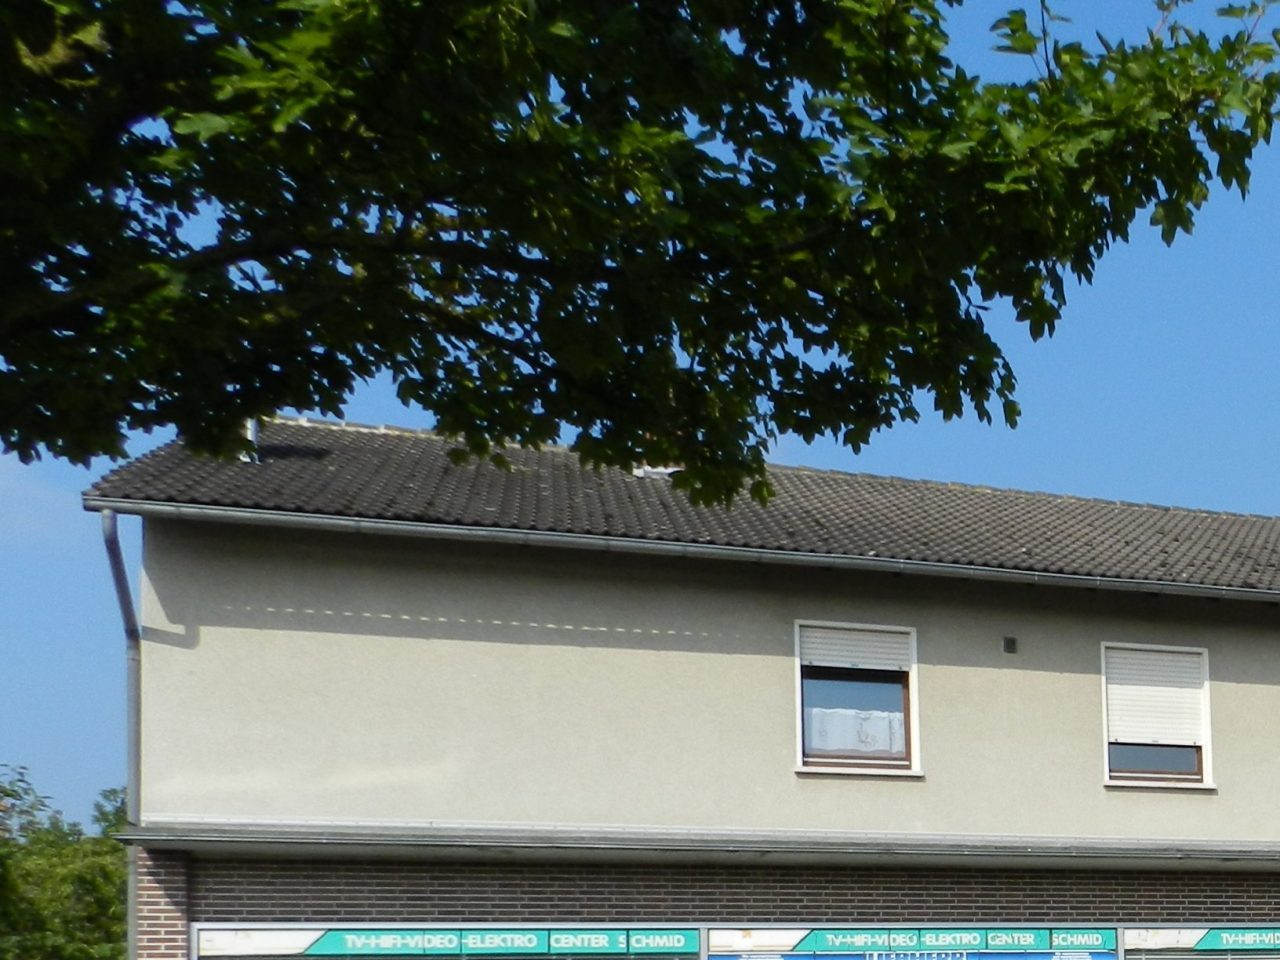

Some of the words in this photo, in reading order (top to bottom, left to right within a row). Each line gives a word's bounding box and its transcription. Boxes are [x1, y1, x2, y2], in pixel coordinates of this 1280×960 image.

[550, 934, 609, 947] CENTER
[987, 933, 1035, 945] CENTER
[1052, 933, 1103, 946] SCHMID
